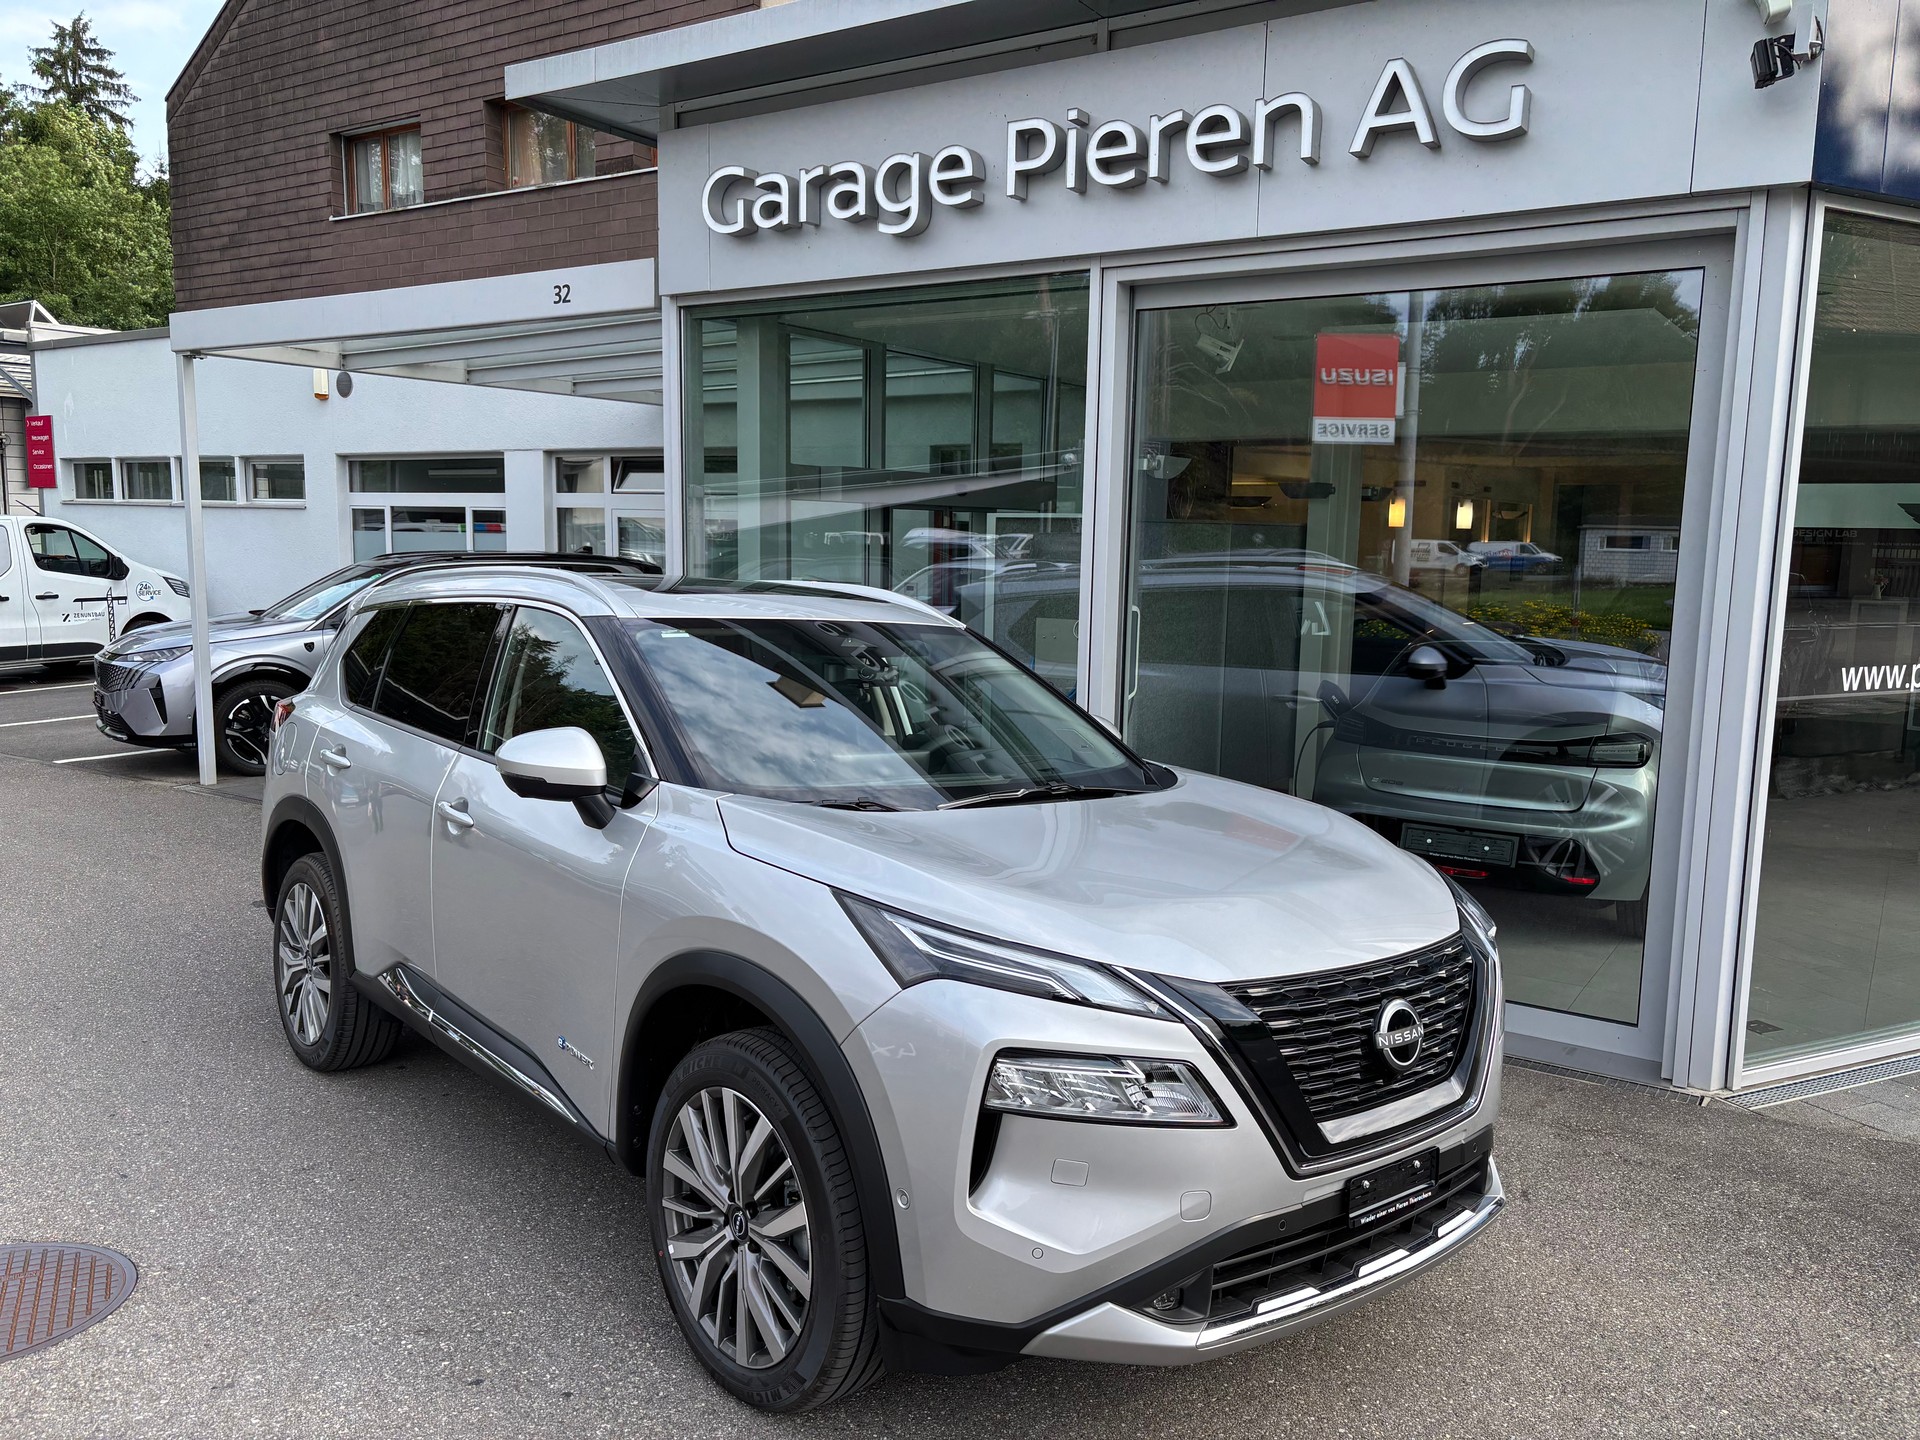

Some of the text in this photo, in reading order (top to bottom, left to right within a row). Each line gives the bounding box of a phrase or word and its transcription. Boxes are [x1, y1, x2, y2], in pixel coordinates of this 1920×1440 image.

[700, 38, 1535, 239] Garage Pieren AG
[553, 283, 571, 305] 32
[139, 583, 152, 591] 24h
[1378, 1023, 1424, 1047] NISSAN
[1360, 1214, 1376, 1225] Wieder
[1376, 1209, 1388, 1219] einer
[1395, 1201, 1409, 1211] Pieren
